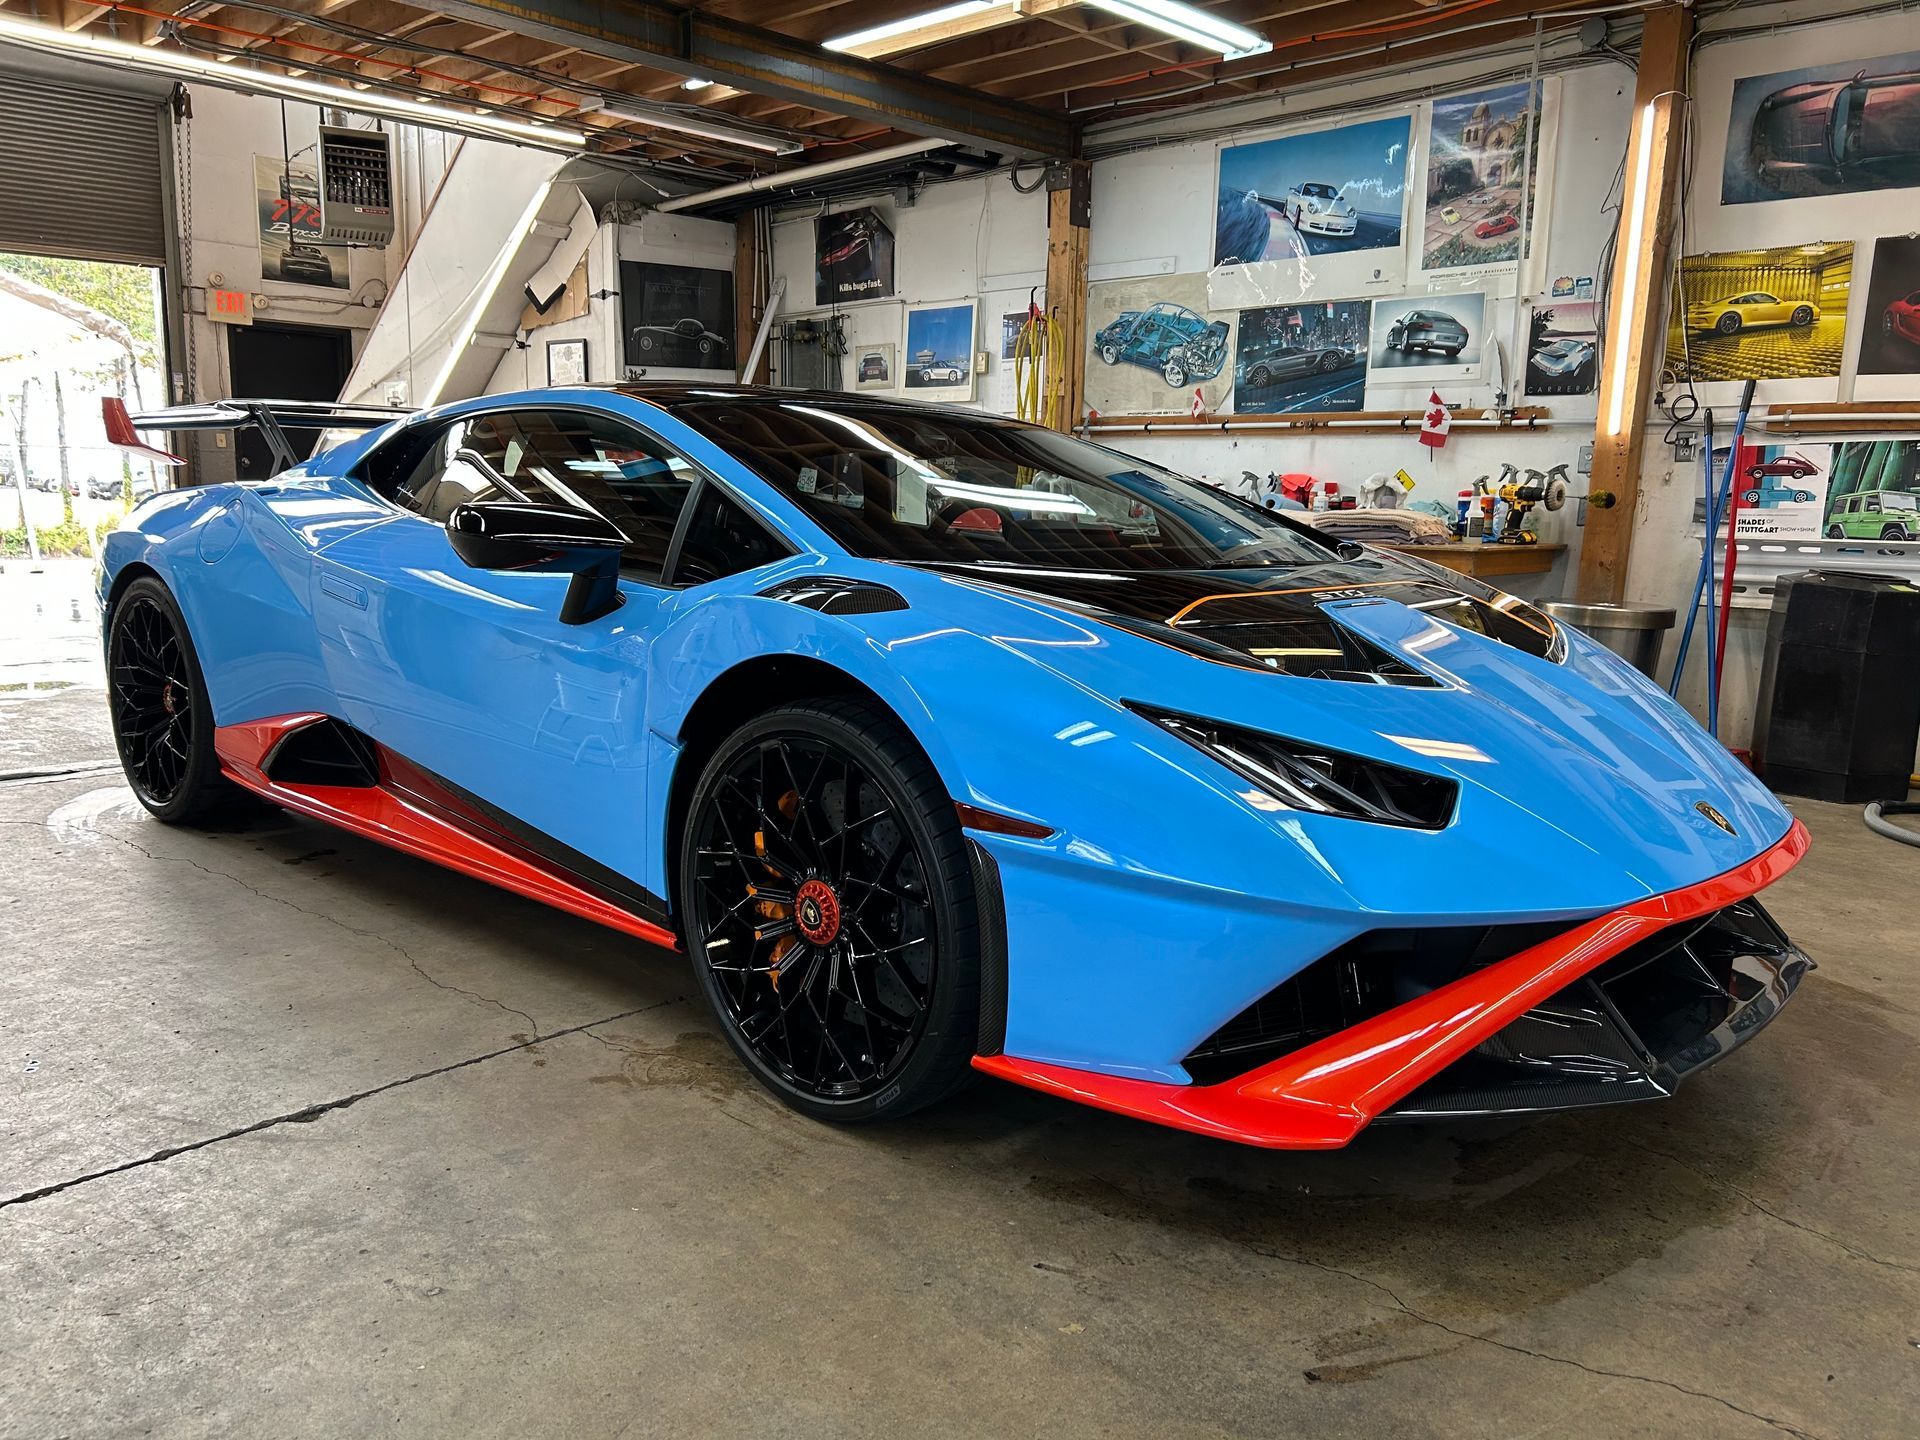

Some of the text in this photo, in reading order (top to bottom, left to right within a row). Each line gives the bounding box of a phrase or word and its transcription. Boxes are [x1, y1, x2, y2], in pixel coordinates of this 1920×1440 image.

[265, 222, 323, 239] Boxs
[839, 279, 883, 292] Kills bugs fast.
[216, 290, 245, 313] EXIT
[1527, 385, 1591, 394] CARRERA
[1737, 526, 1779, 534] STUTTGART
[1311, 589, 1366, 600] STO
